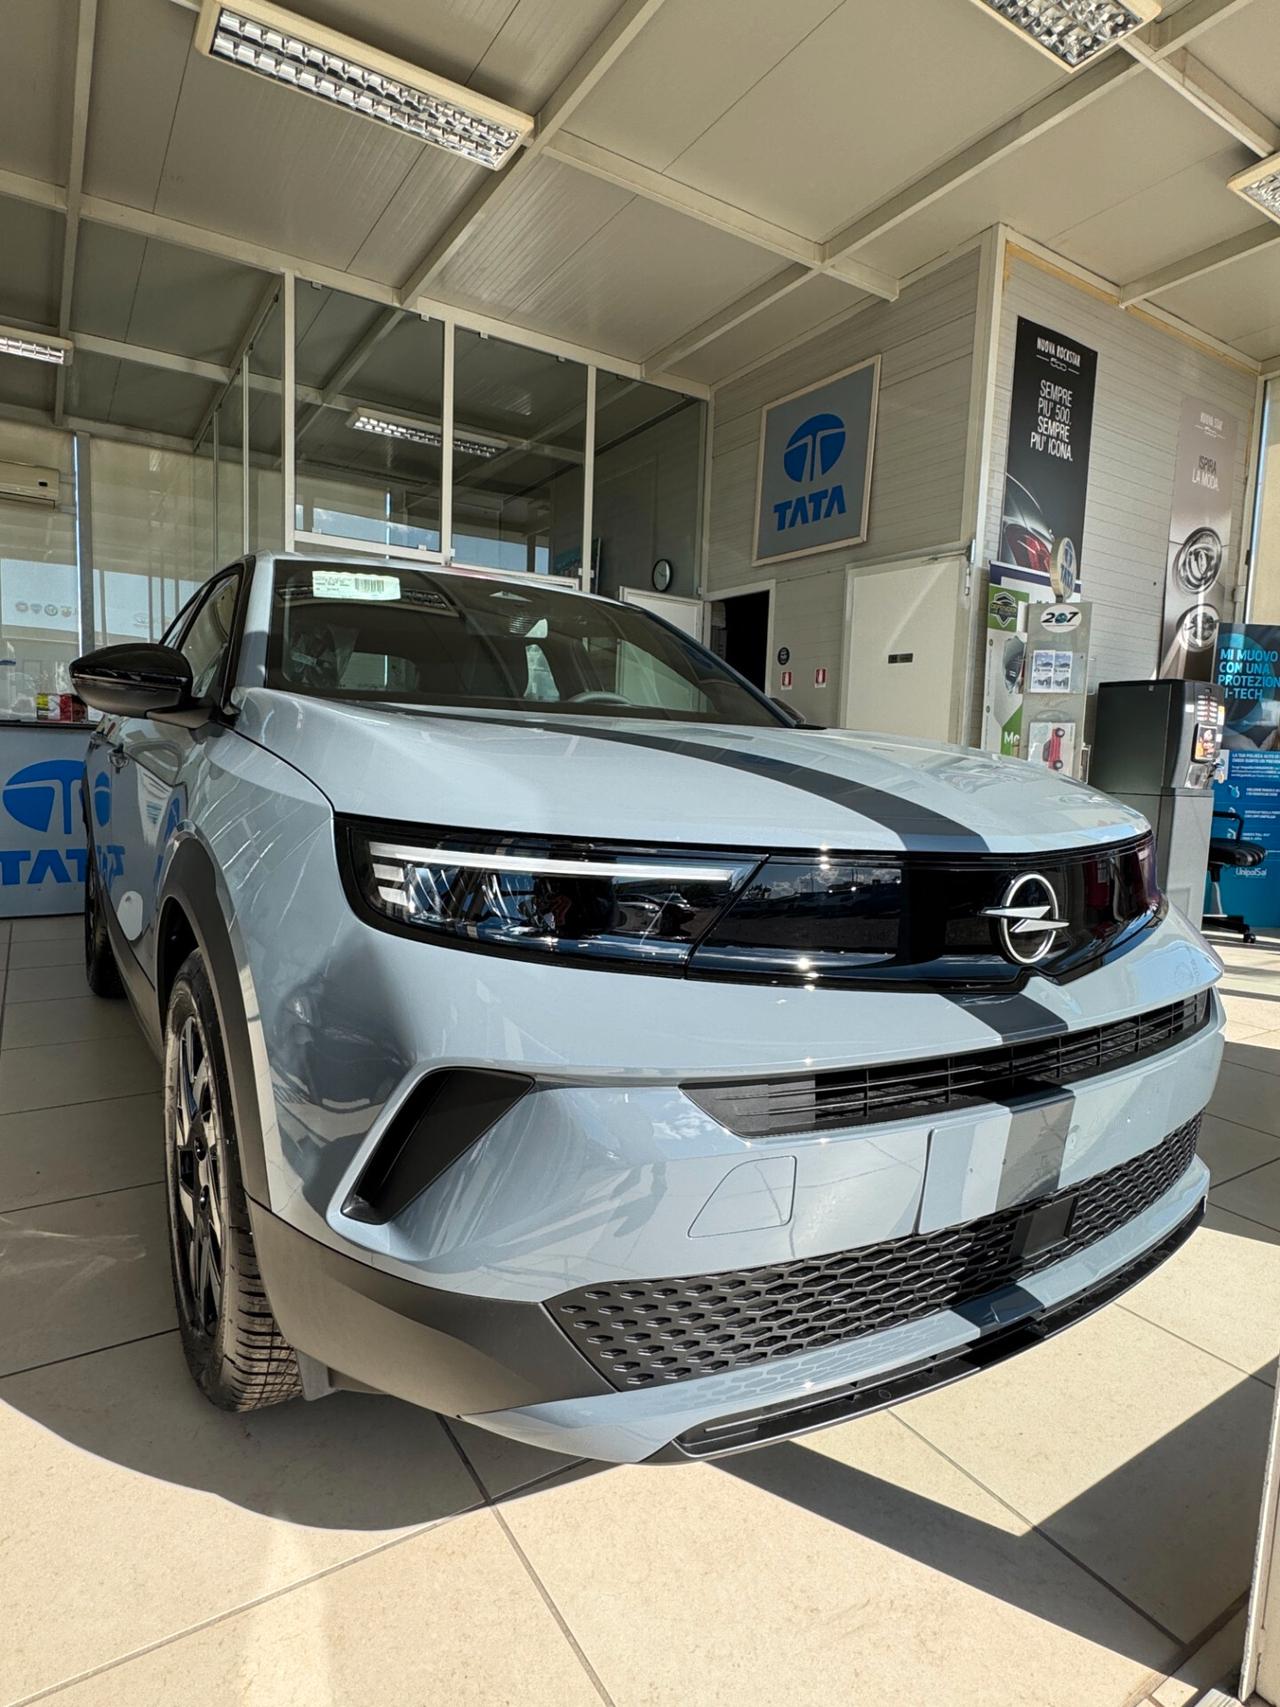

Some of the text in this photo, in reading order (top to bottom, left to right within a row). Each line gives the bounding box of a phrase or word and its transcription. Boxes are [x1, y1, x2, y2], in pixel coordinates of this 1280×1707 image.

[1056, 344, 1081, 367] ROCKSTAR
[1040, 379, 1073, 408] SEMPRE
[1038, 396, 1072, 426] PIU' 500.
[1037, 415, 1071, 443] SEMPRE
[1030, 431, 1073, 461] PIU' ICONA.
[773, 484, 847, 531] TATA
[1219, 661, 1271, 675] CON UNA
[1220, 648, 1279, 663] MI MUOVO
[0, 849, 88, 885] TAT
